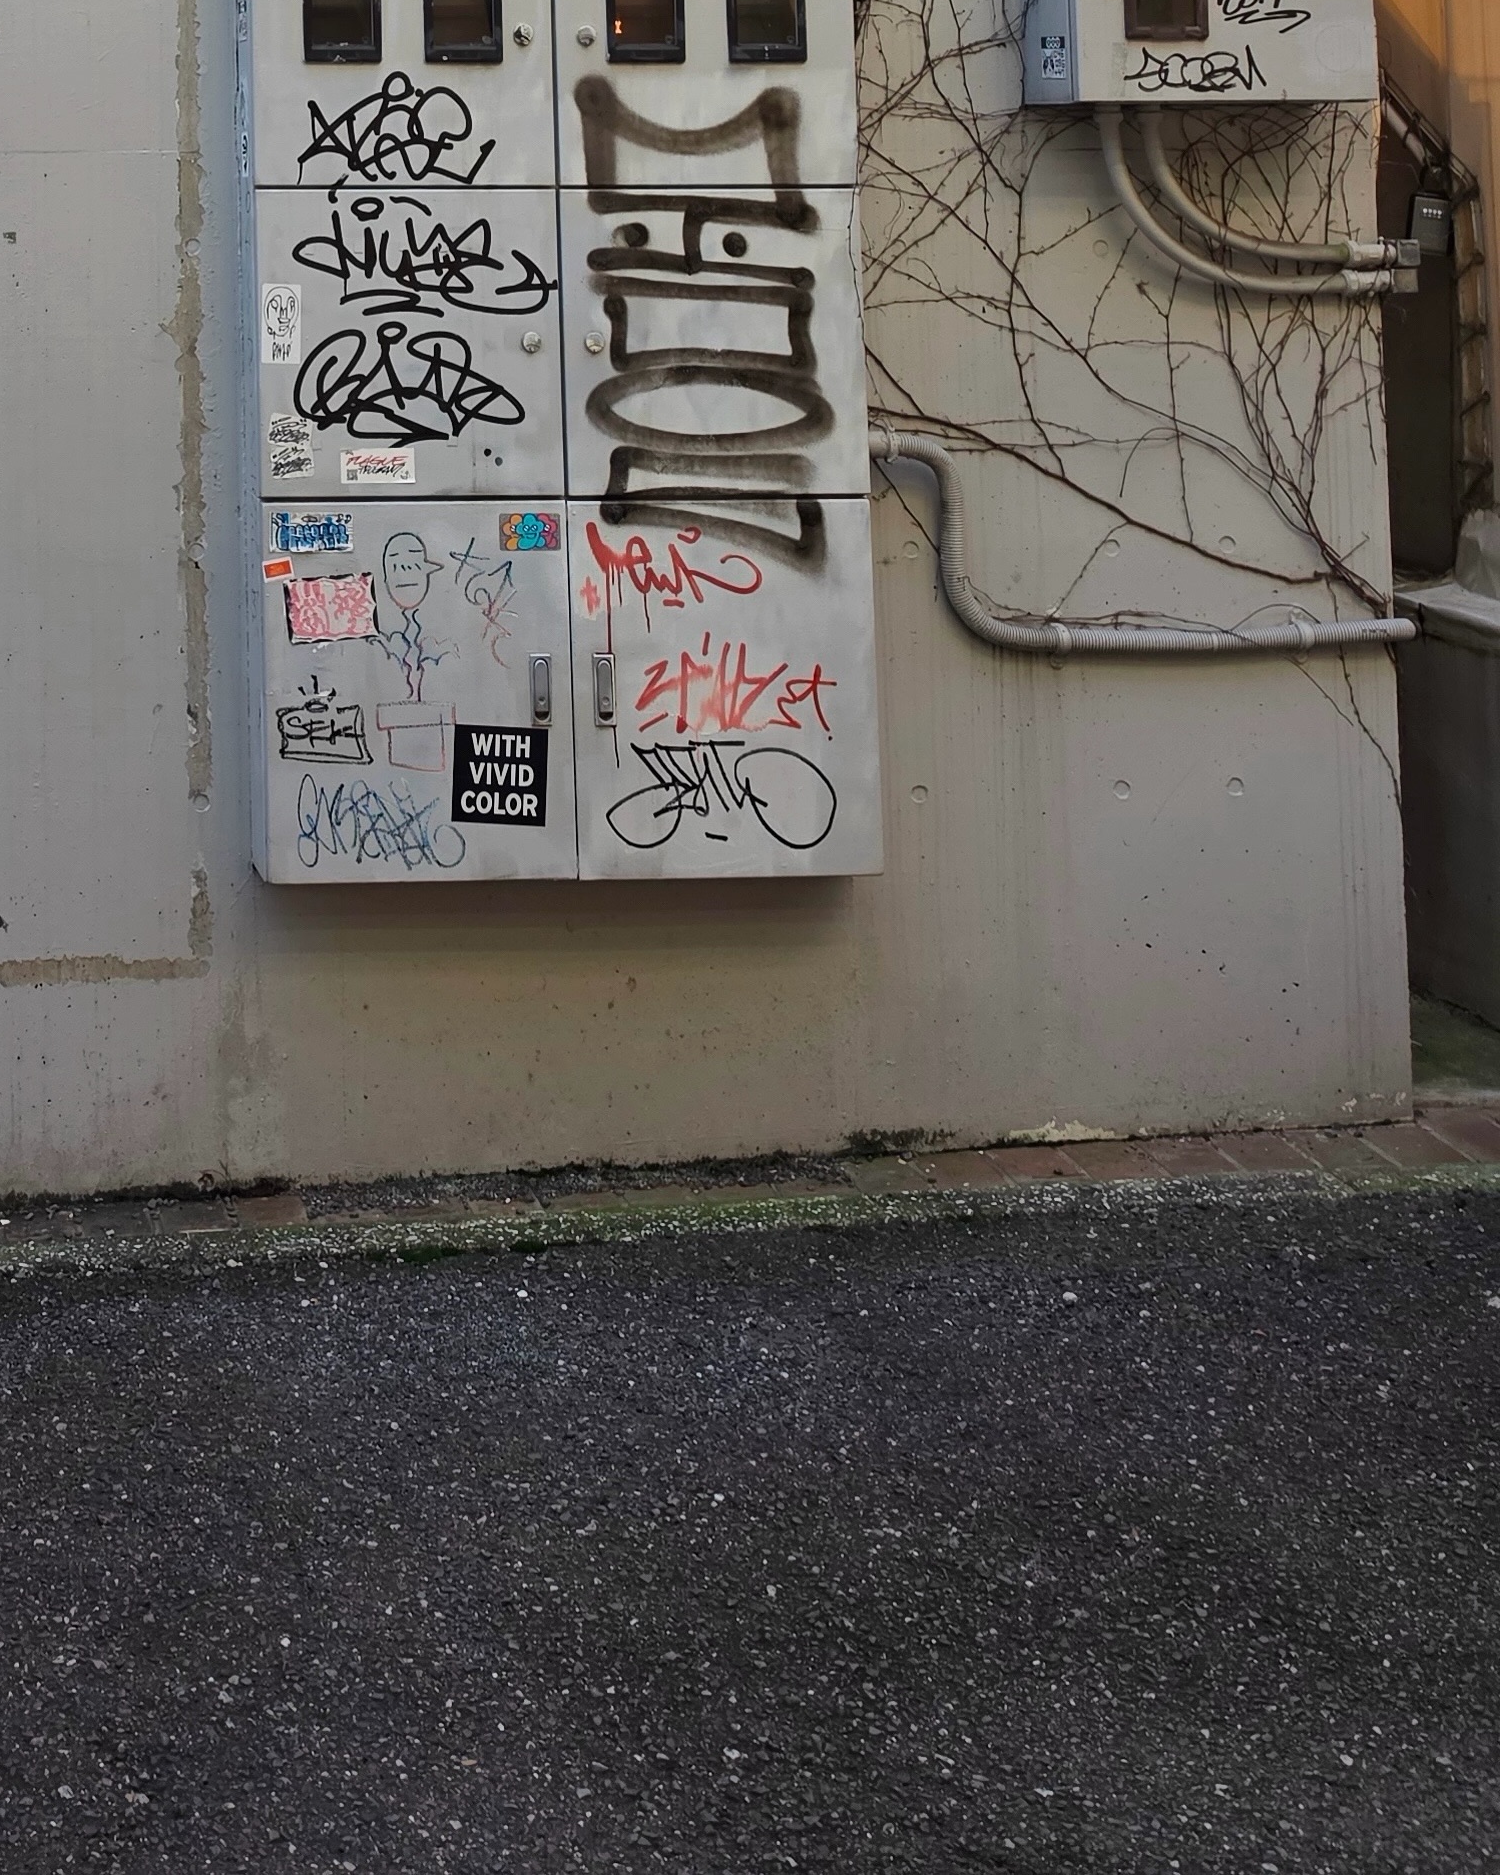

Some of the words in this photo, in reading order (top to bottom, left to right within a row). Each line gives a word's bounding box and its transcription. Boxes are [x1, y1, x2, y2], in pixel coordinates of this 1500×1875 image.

[471, 732, 531, 758] WITH
[469, 761, 534, 787] VIVID
[460, 790, 538, 817] COLOR
